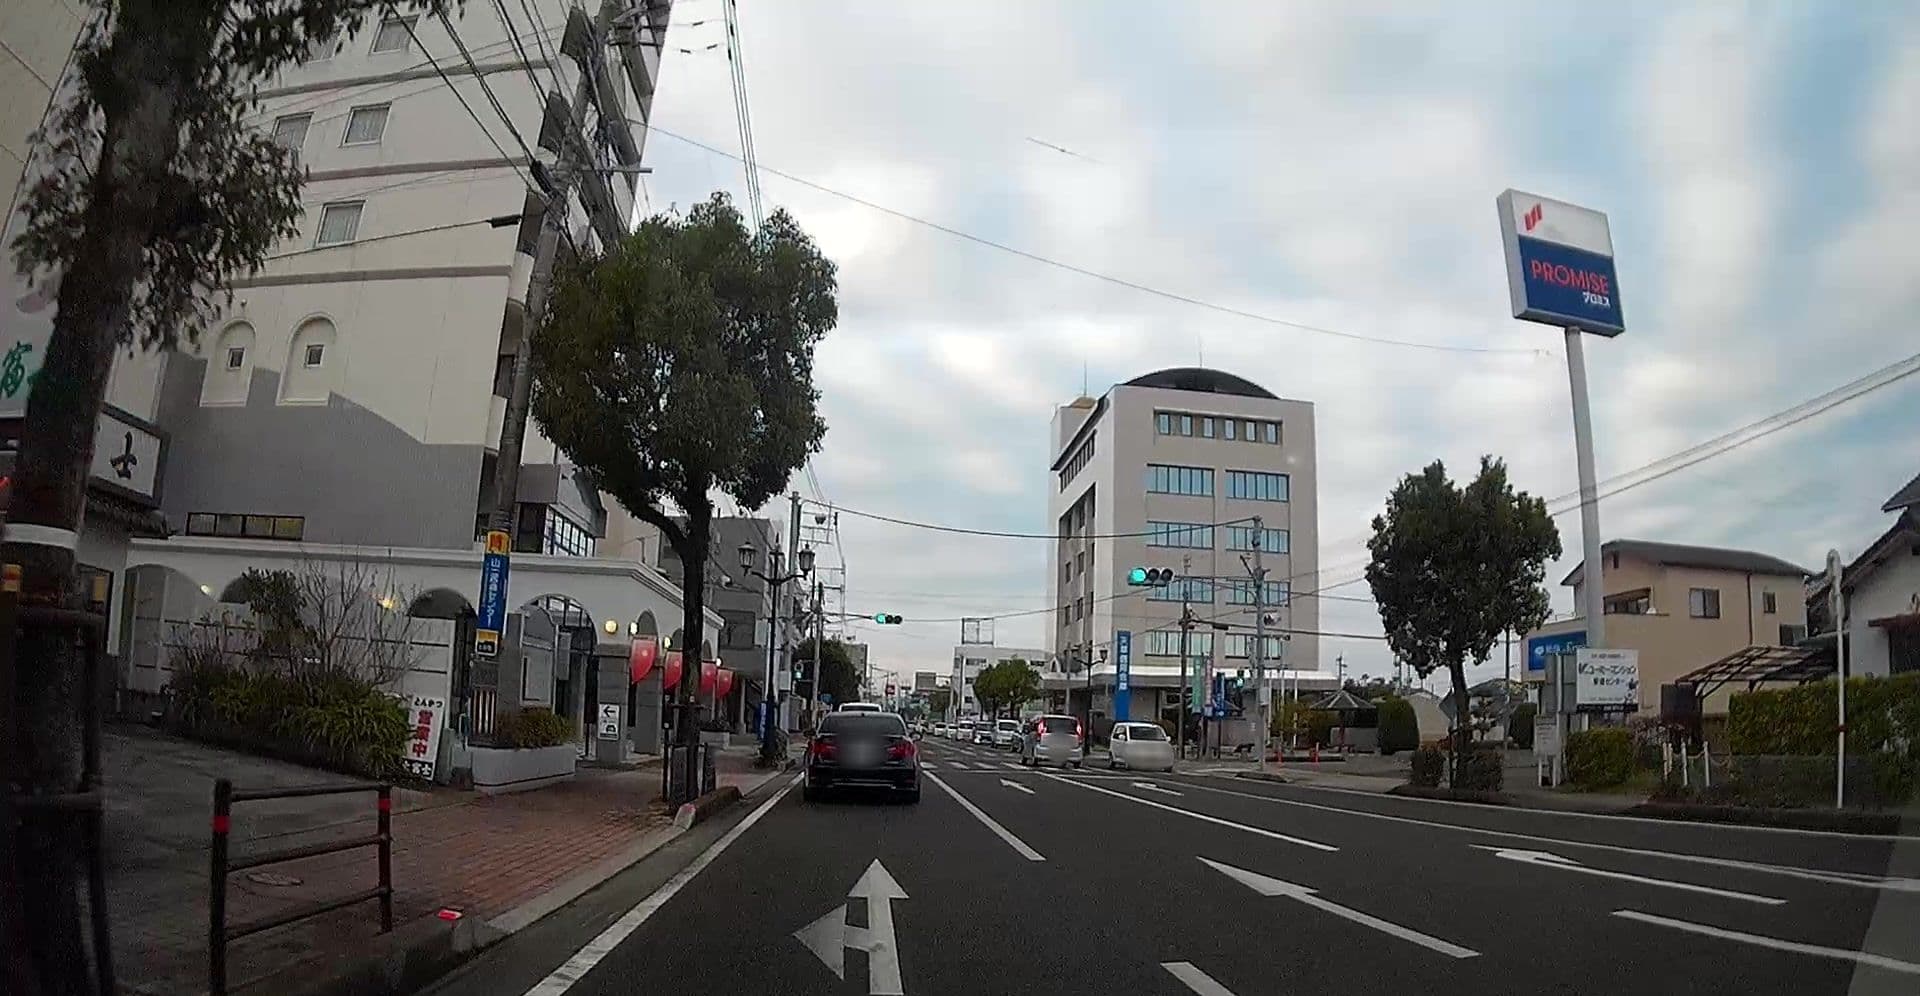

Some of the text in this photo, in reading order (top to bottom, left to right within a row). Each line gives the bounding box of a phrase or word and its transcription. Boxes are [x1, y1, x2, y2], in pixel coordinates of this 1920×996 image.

[1531, 259, 1609, 295] PROMISE
[1582, 291, 1611, 309] プロミス
[414, 697, 443, 708] とんかつ
[412, 709, 433, 758] 営業中
